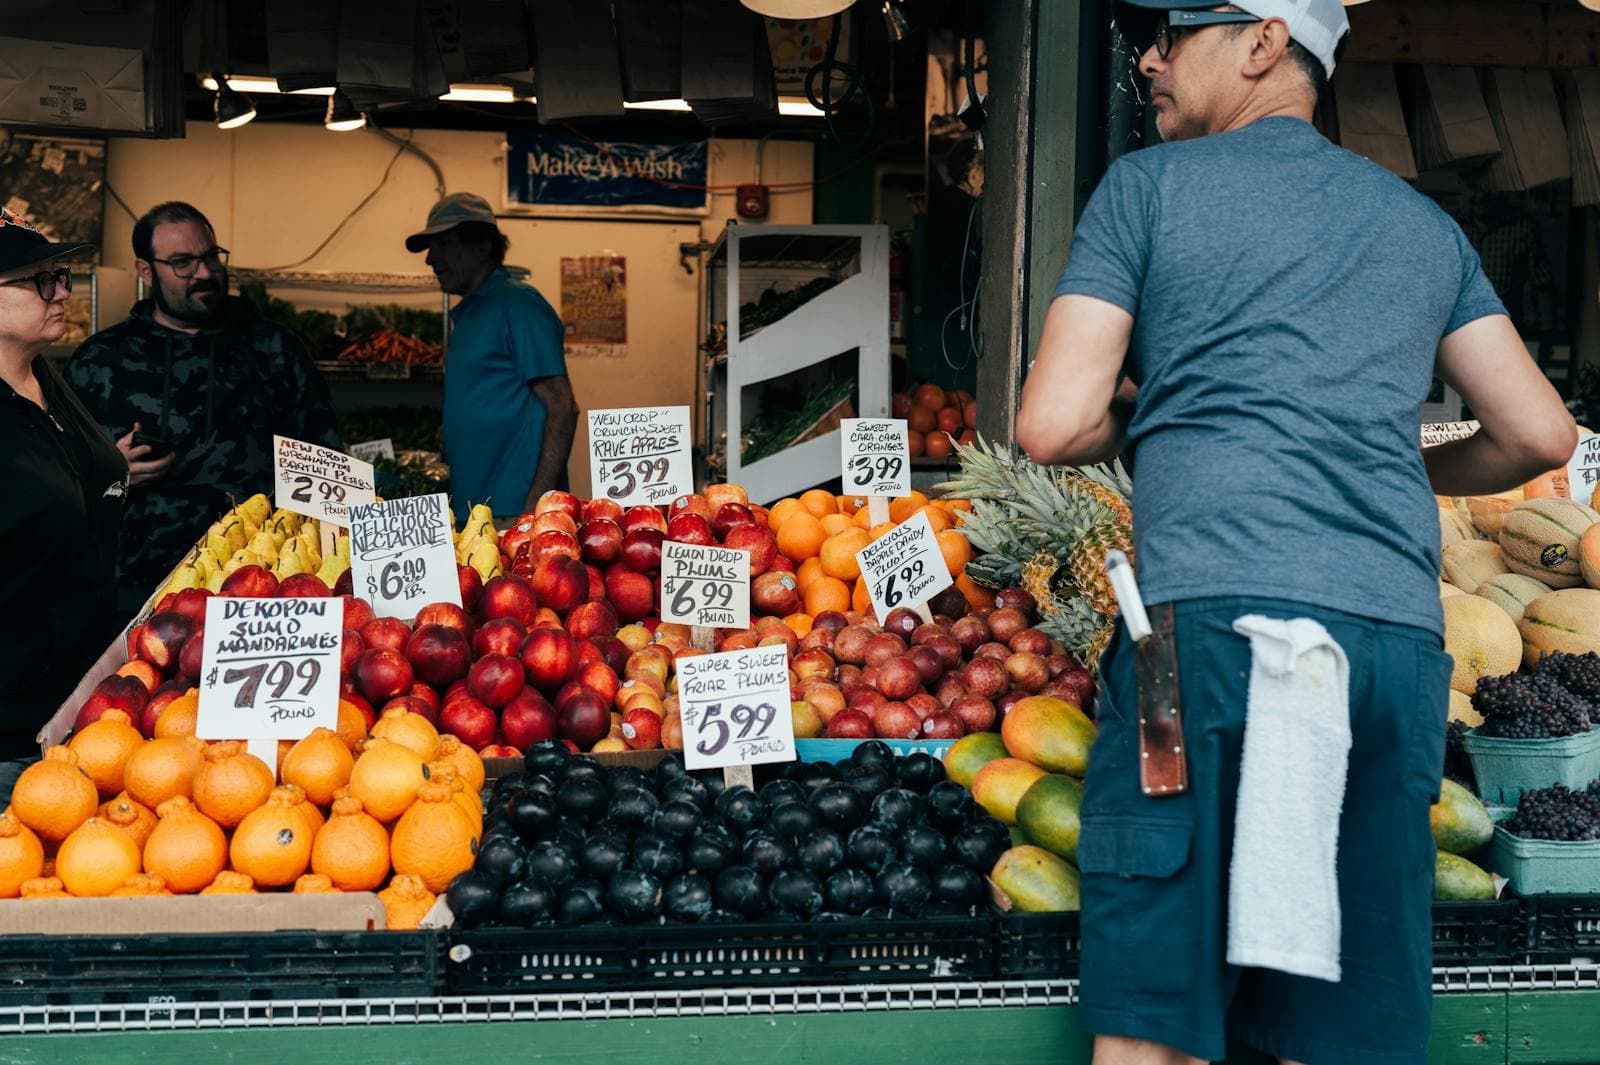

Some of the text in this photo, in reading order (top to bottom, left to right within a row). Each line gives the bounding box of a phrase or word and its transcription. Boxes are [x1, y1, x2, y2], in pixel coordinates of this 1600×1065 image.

[593, 425, 648, 437] CRUNCHY
[856, 421, 893, 432] SWEET
[280, 439, 312, 453] NEW
[316, 449, 349, 464] CROP
[593, 435, 679, 458] RAVE APPLES
[858, 442, 904, 452] ORANGES
[279, 448, 352, 473] WASHINGTON
[645, 484, 678, 502] POUND
[873, 483, 902, 494] POUND
[348, 494, 442, 523] WASHINGTON
[351, 512, 447, 541] DELICIOUS
[352, 527, 447, 555] NECTARINE
[862, 524, 912, 561] DELICIOUS
[866, 526, 925, 571] DAPPLE DANDY
[666, 546, 743, 564] LEMON DROP
[674, 560, 737, 579] PLUMS
[906, 575, 936, 599] POUND
[223, 599, 327, 620] DEKOPON
[697, 608, 735, 624] POUND
[230, 618, 301, 637] SUMO
[683, 653, 786, 675] SUPER SWEET
[684, 671, 787, 696] FRIAR PLUMS
[269, 705, 316, 723] POUND
[739, 739, 785, 761] POUND
